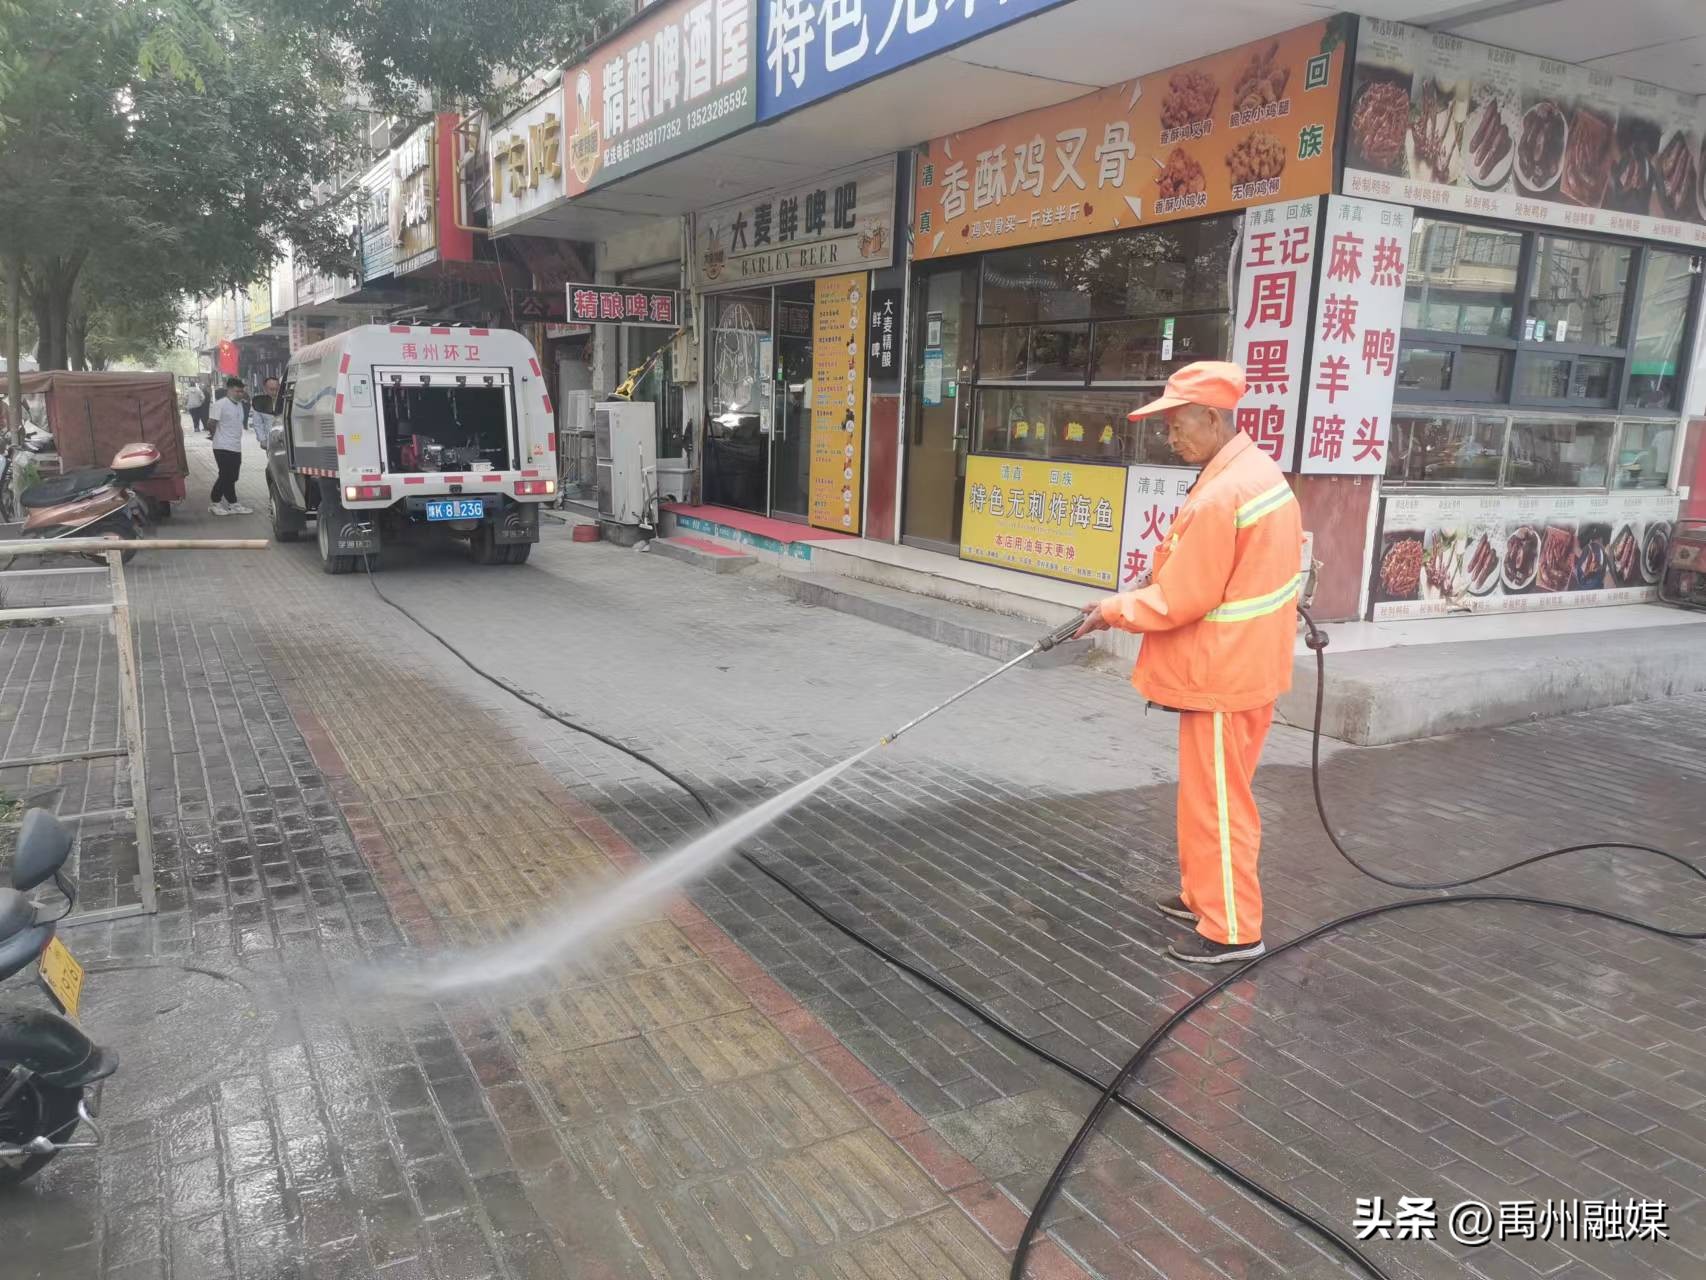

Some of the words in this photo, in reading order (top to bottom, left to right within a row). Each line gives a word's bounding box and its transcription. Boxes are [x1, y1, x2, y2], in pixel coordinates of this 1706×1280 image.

[603, 0, 748, 140] 精酿啤酒屋
[767, 0, 1010, 97] 特色
[687, 86, 748, 130] 13523285592
[1297, 54, 1331, 160] 回族
[940, 120, 1136, 222] 香酥鸡叉骨
[731, 181, 857, 253] 大麦鲜啤吧
[919, 163, 935, 235] 清真
[972, 203, 1080, 239] 鸡叉骨买一斤送半斤
[1250, 208, 1276, 226] 清真
[1286, 203, 1313, 221] 回族
[1338, 204, 1363, 221] 清真
[741, 253, 793, 276] BARLEY
[800, 243, 838, 268] BEER
[1246, 226, 1310, 268] 王记
[574, 289, 673, 321] 精酿啤酒
[401, 343, 481, 361] 禹州环卫
[881, 298, 894, 368] 大麦精酿
[1308, 231, 1365, 462] 麻辣羊蹄
[1236, 271, 1298, 462] 周黑鸭
[969, 483, 1114, 532] 特色无刺炸海鱼
[1138, 477, 1166, 495] 清真
[994, 534, 1076, 561] 本店用油每天更换
